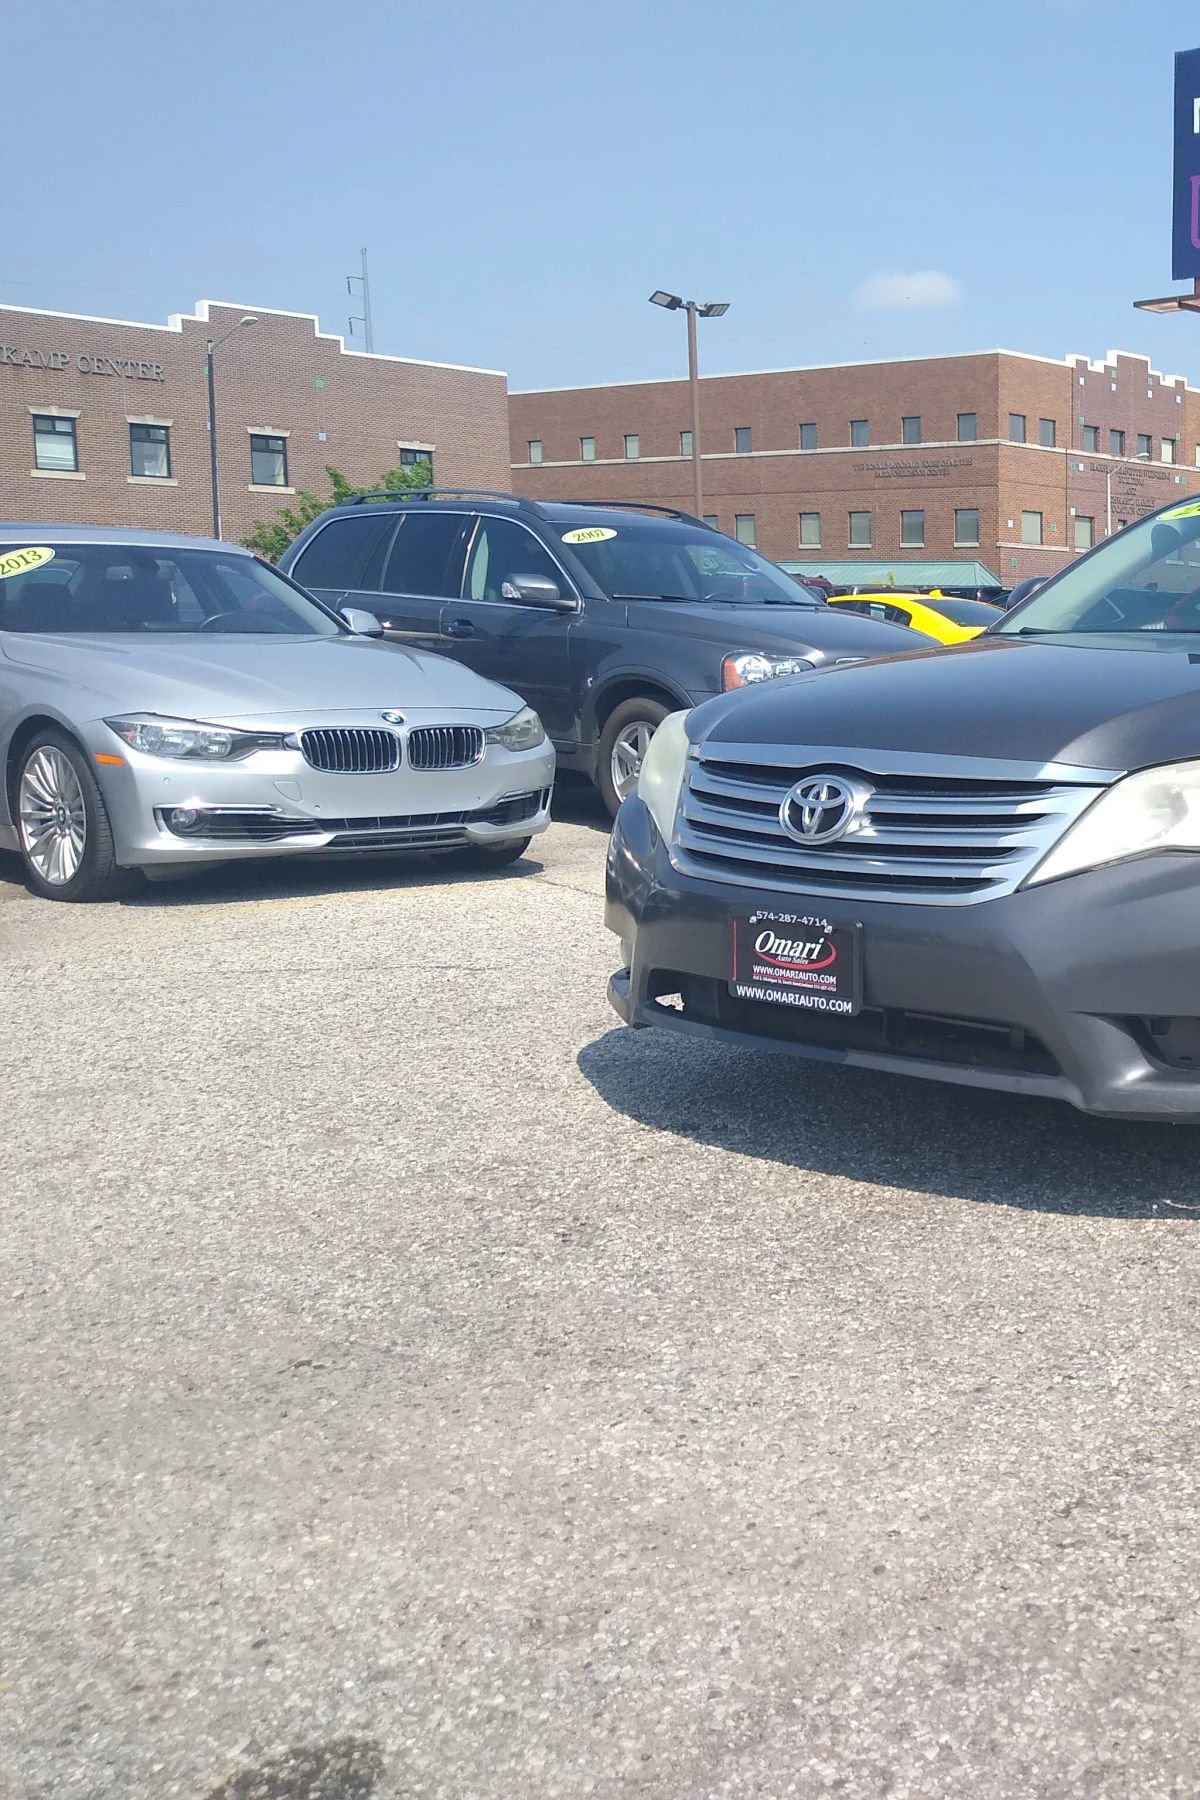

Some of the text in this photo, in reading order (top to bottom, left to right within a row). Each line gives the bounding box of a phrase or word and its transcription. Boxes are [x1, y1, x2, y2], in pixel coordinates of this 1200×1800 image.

[77, 355, 165, 382] CENTER
[572, 529, 605, 542] 2007
[0, 550, 42, 575] 2013
[756, 910, 827, 928] 574-287-4714
[754, 930, 825, 960] Omari
[776, 954, 809, 965] Auto Sales
[752, 965, 837, 985] WWW.OMARIAUTO.COM
[736, 984, 852, 1013] WWW.OMARIAUTO.COM
